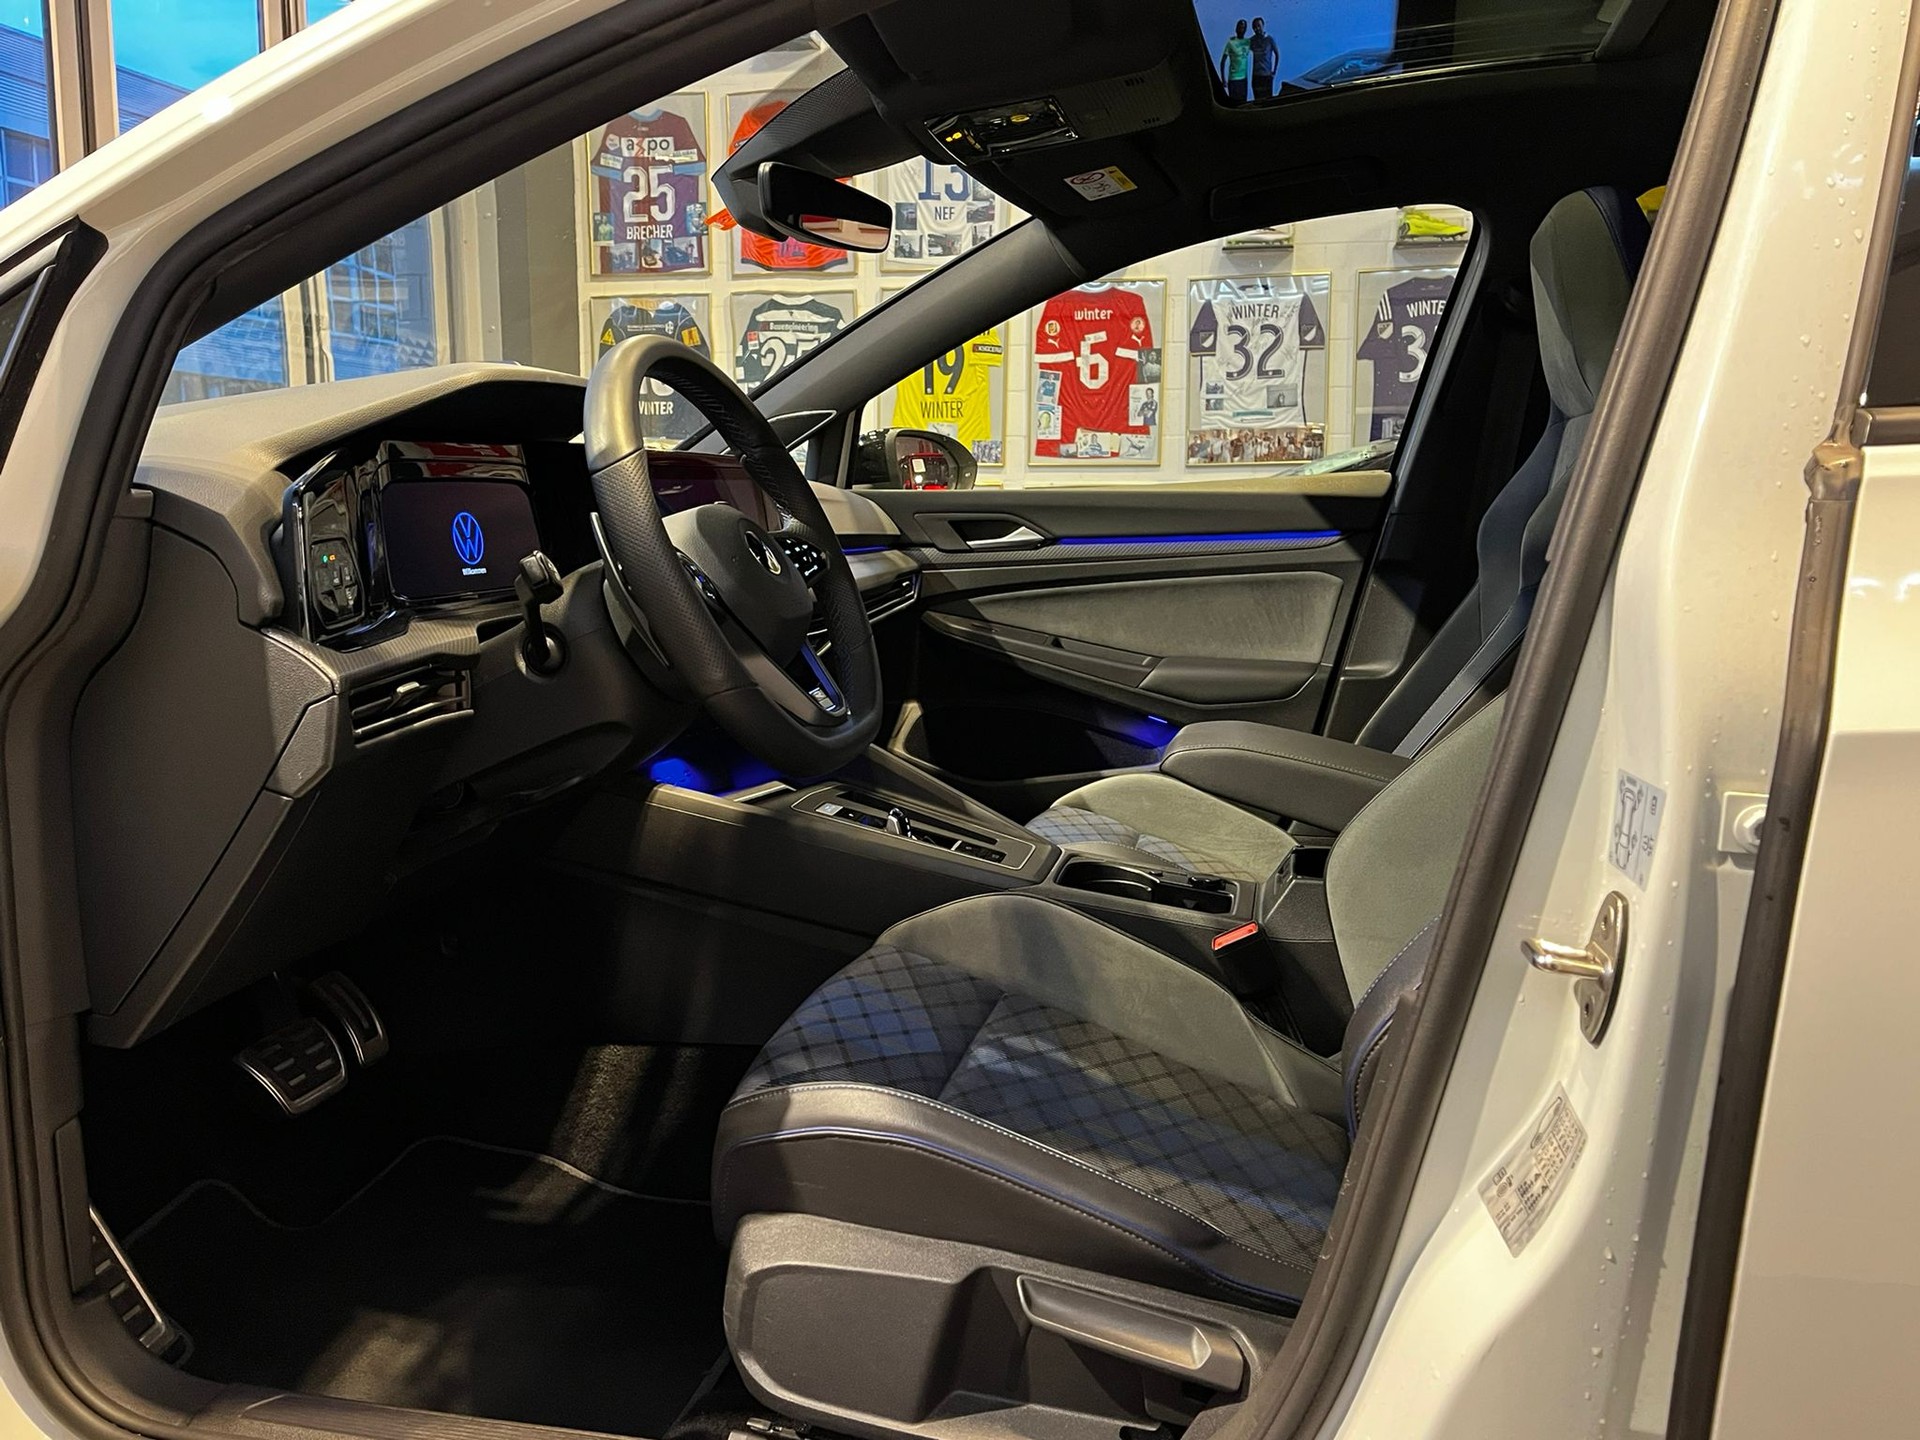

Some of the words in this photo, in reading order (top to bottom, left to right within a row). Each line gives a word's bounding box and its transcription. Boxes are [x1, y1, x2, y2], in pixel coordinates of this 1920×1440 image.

[623, 165, 676, 222] 25
[934, 206, 956, 220] NEF
[626, 224, 674, 240] BRECHER
[1074, 307, 1114, 320] winter
[1231, 303, 1280, 320] WINTER
[1406, 299, 1447, 318] WINTE
[1075, 330, 1109, 390] 6
[1226, 323, 1285, 381] 32
[924, 344, 965, 395] 19
[920, 400, 964, 419] WINTER
